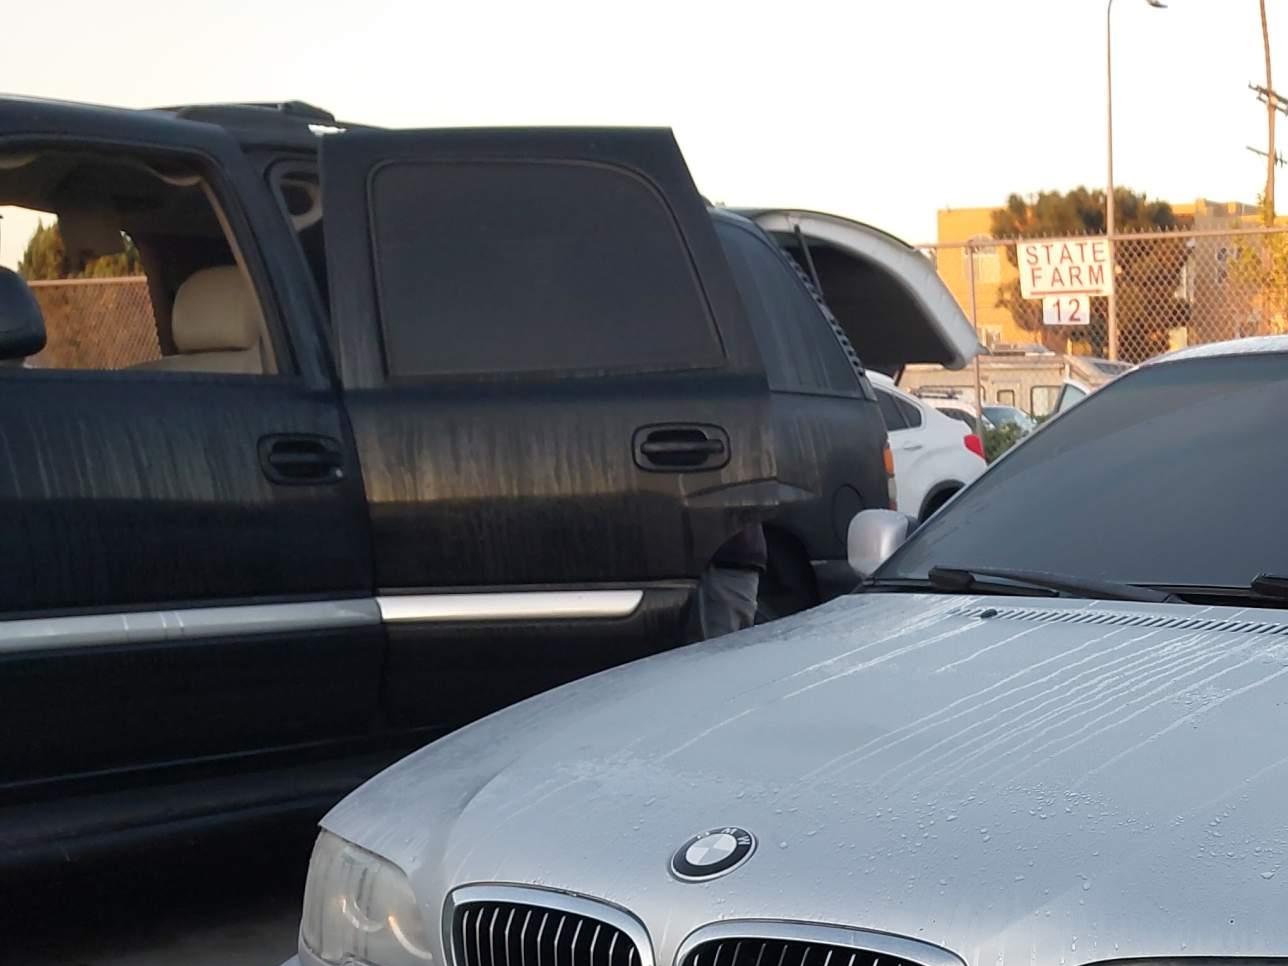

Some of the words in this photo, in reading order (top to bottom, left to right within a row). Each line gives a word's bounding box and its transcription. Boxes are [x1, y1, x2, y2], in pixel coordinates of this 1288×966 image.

[1025, 241, 1105, 266] STATE
[1030, 264, 1105, 289] FARM
[1053, 298, 1082, 322] 12
